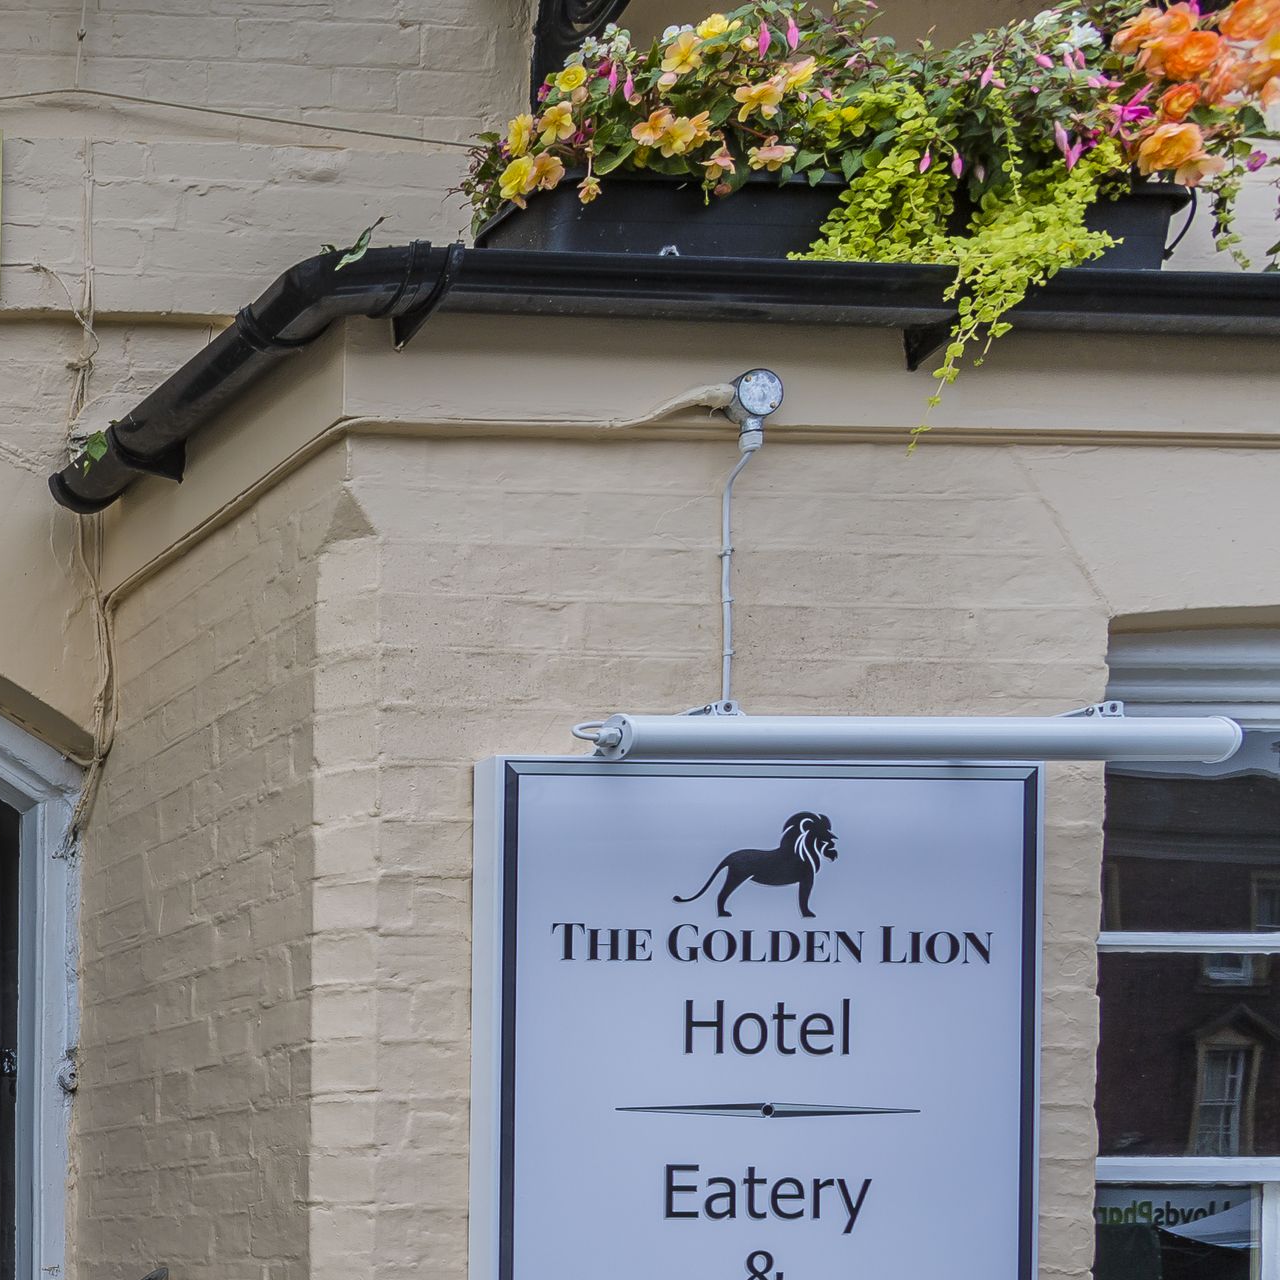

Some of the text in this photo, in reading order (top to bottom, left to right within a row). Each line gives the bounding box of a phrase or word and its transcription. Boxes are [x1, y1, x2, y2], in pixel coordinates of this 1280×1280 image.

[552, 922, 994, 965] THE GOLDEN LION
[684, 998, 852, 1056] Hotel
[665, 1162, 872, 1235] Eatery
